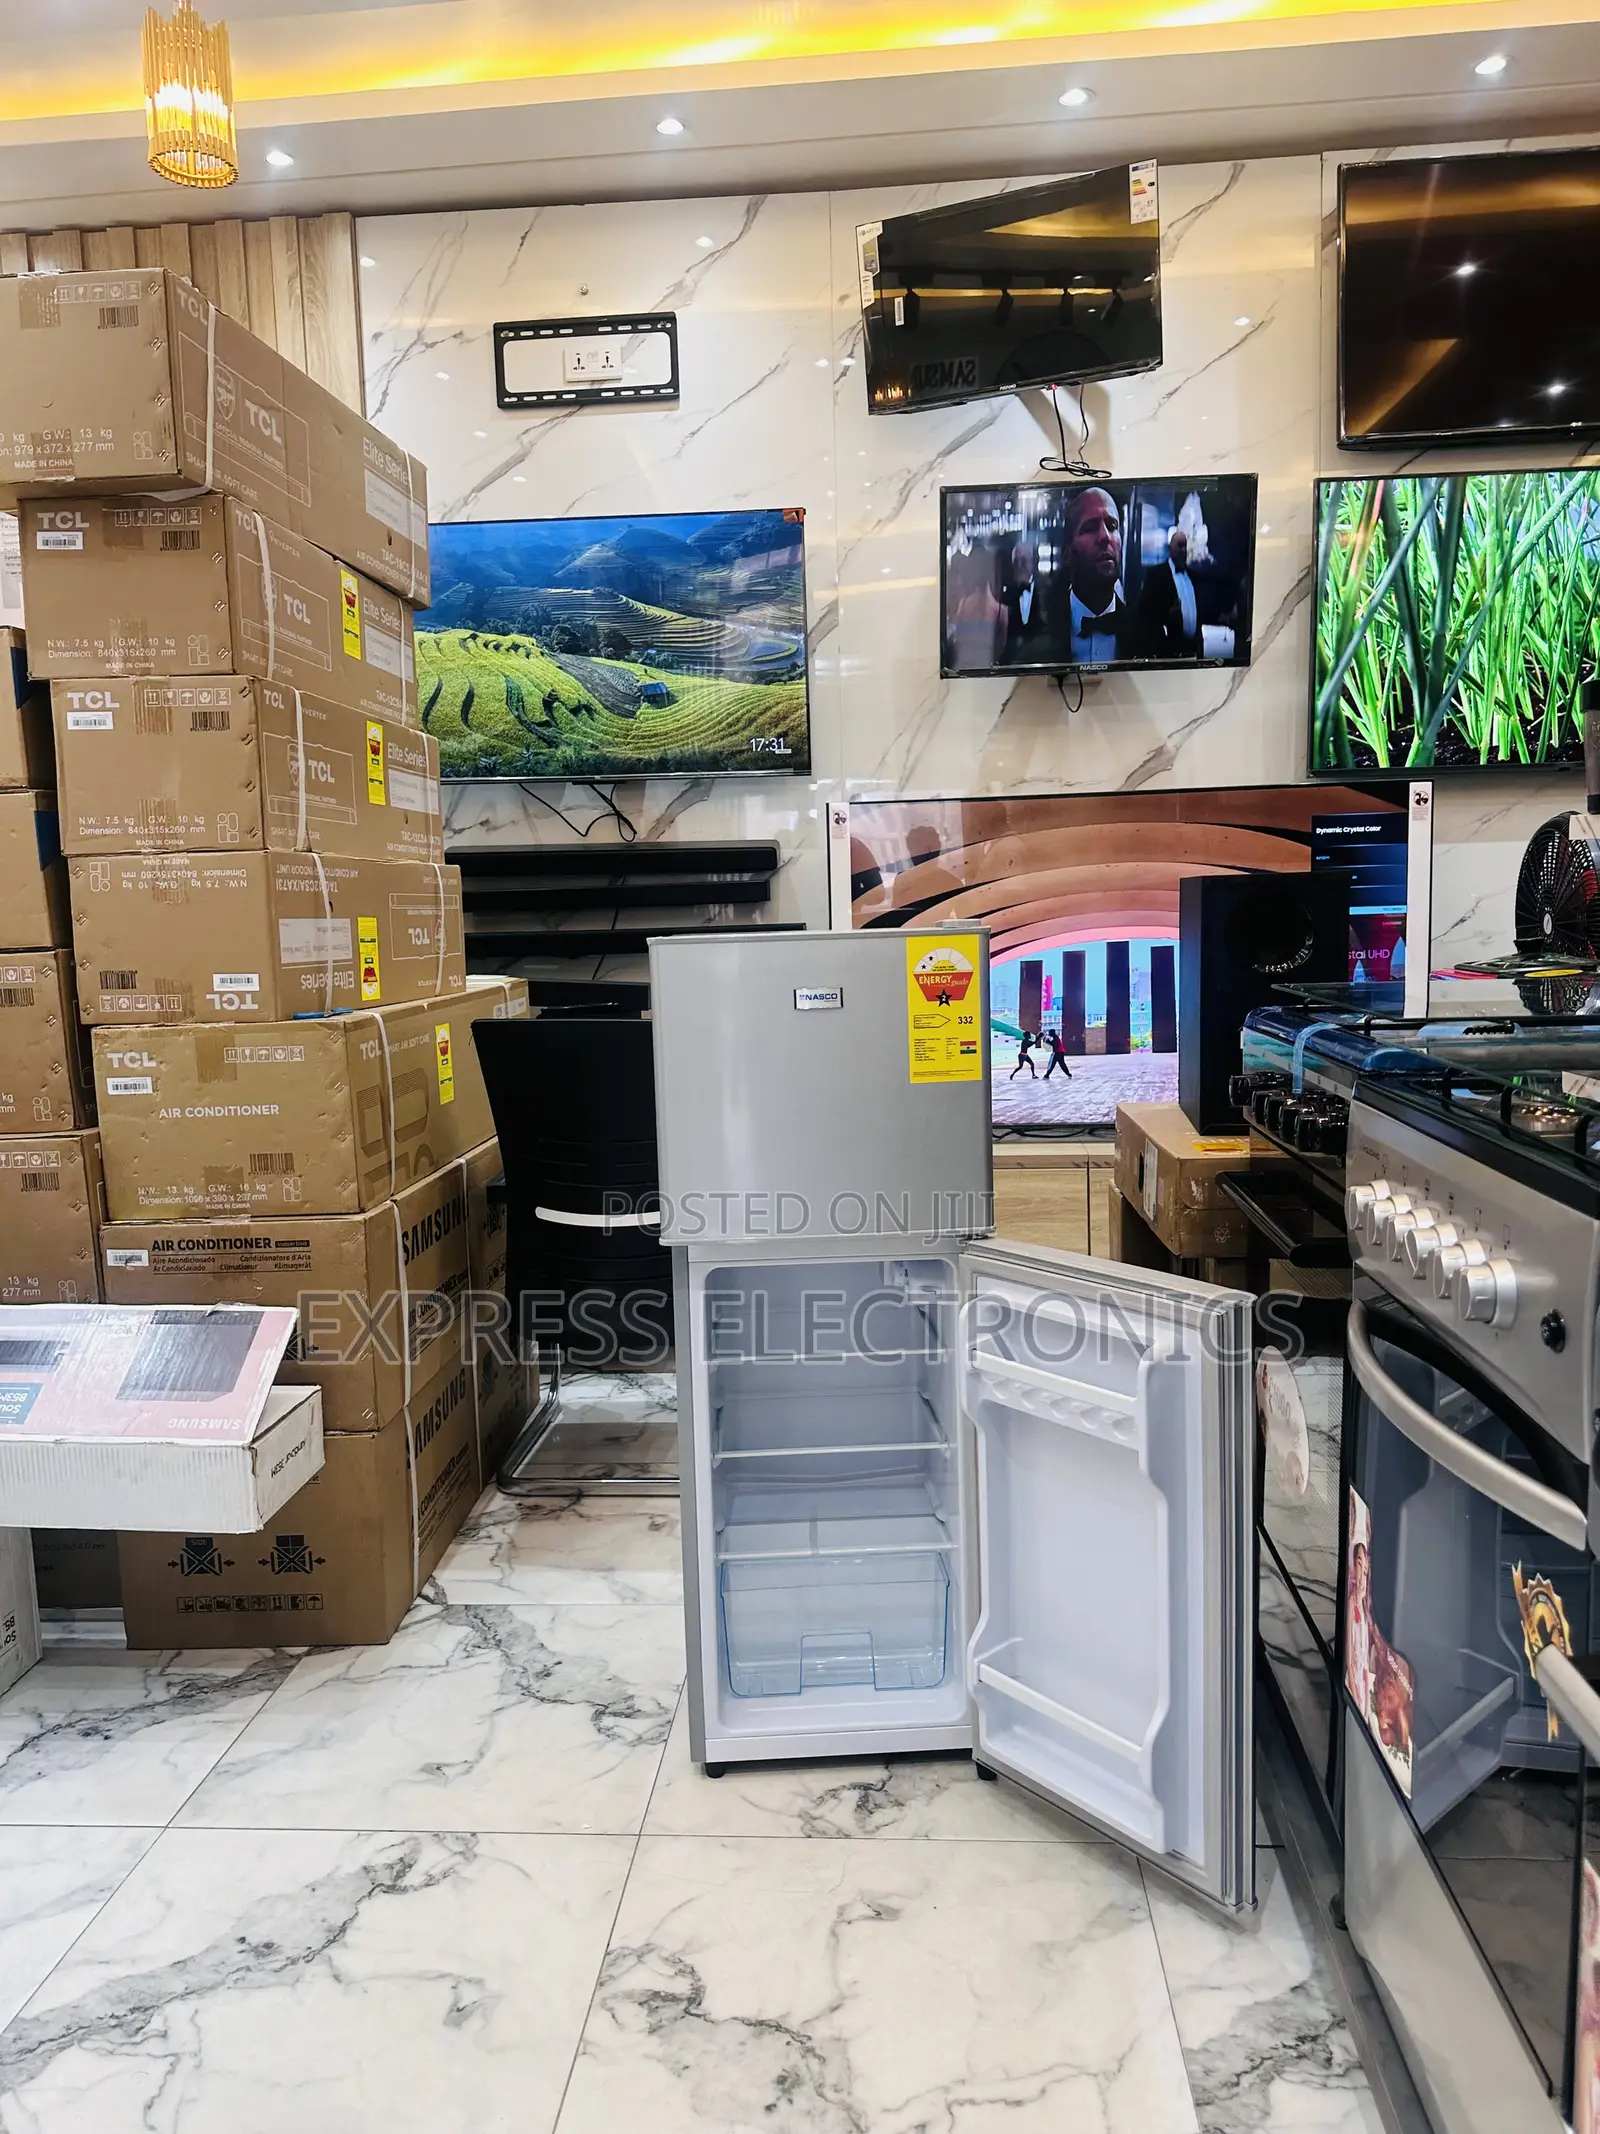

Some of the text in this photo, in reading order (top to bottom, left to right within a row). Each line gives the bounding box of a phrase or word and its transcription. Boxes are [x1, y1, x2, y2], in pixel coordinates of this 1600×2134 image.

[176, 285, 208, 326] TCL
[244, 398, 283, 445] TCL
[13, 431, 25, 443] kg
[79, 428, 93, 438] 13
[100, 428, 113, 438] kg
[14, 445, 34, 455] 979
[43, 443, 64, 454] 372
[73, 442, 94, 452] 277
[95, 442, 115, 451] mm
[14, 460, 37, 468] MADE
[48, 458, 74, 467] CHINA
[362, 436, 412, 486] Elite Serie
[36, 511, 90, 529] TCL
[235, 509, 257, 535] TCL
[283, 594, 311, 625] TCL
[363, 596, 380, 621] Elite
[47, 639, 70, 648] N.W.:
[94, 638, 104, 649] kg
[148, 637, 159, 646] 10
[165, 637, 175, 647] kg
[48, 649, 93, 659] Dimension:
[160, 649, 177, 657] mm
[1079, 663, 1108, 672] NASCO
[66, 690, 120, 709] TCL
[263, 688, 285, 710] TCL
[749, 737, 785, 752] 17:31
[387, 742, 427, 768] Elite Series
[307, 759, 335, 784] TCL
[104, 816, 119, 825] 7.5
[123, 816, 135, 827] kg
[177, 815, 188, 824] 10
[194, 815, 205, 825] kg
[79, 825, 206, 836] Dimension: 840x315x260 mm
[1315, 826, 1343, 835] Dynamic
[1342, 826, 1365, 835] Crystal
[164, 838, 185, 846] CHINA
[202, 868, 247, 878] Dimension:
[122, 880, 133, 889] kg
[138, 881, 149, 889] 10
[190, 879, 201, 889] kg
[205, 880, 220, 888] 7.5
[224, 879, 247, 888] N.W.:
[407, 927, 431, 946] TCL
[1367, 948, 1391, 959] UHD
[333, 969, 355, 989] Elite
[448, 975, 463, 987] TCL
[918, 974, 969, 988] ENERGY guide
[205, 992, 259, 1011] TCL
[805, 992, 838, 1001] NASCO
[941, 994, 947, 1002] 2
[957, 1015, 974, 1025] 332
[359, 1037, 383, 1061] TCL
[107, 1051, 157, 1069] TCL
[1, 1092, 14, 1103] kg
[158, 1104, 280, 1120] AIR CONDITIONER
[137, 1186, 160, 1195] N.W.:
[166, 1185, 178, 1194] 13
[183, 1185, 195, 1195] kg
[208, 1184, 232, 1193] G.W.:
[255, 1182, 267, 1193] kg
[138, 1195, 184, 1206] Dimension:
[236, 1192, 251, 1202] 297
[252, 1192, 268, 1201] mm
[151, 1239, 175, 1252] AIR
[178, 1237, 273, 1251] CONDITIONER
[152, 1256, 167, 1264] Aire
[167, 1255, 216, 1264] Acondicionado
[239, 1254, 291, 1262] Condizionatore
[153, 1264, 161, 1272] Ar
[219, 1262, 258, 1271] Climatiseur
[8, 1275, 39, 1287] 13 kg
[2, 1287, 41, 1297] 277 mm
[167, 1417, 243, 1430] SAMSUNG
